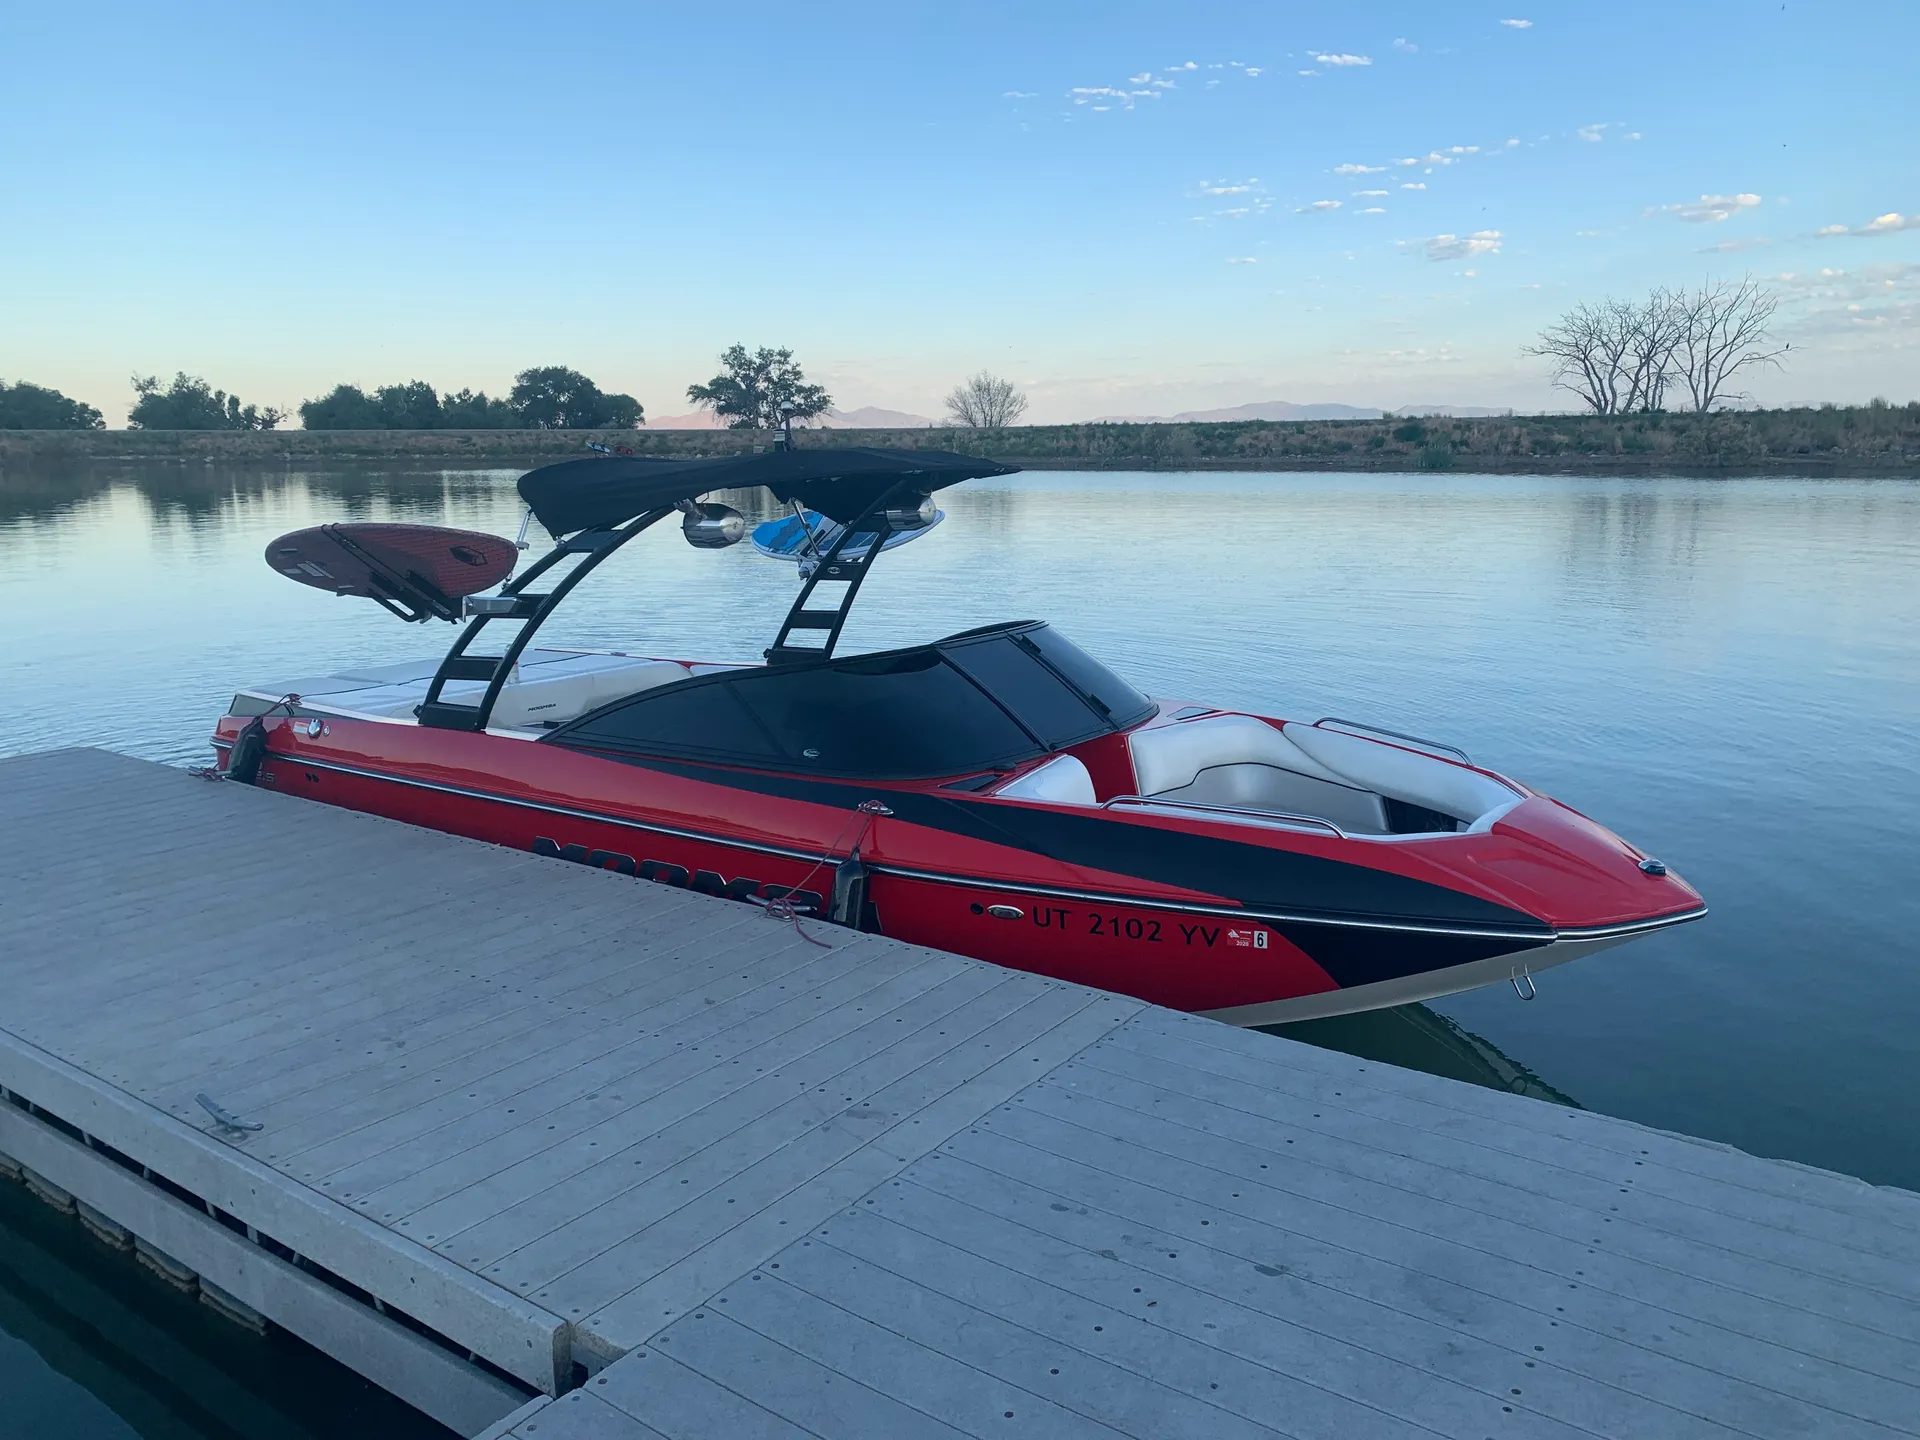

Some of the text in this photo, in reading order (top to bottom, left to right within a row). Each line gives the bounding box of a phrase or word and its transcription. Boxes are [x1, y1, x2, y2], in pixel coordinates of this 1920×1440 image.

[1033, 906, 1220, 947] UT 2102 YV
[1257, 932, 1264, 947] 6
